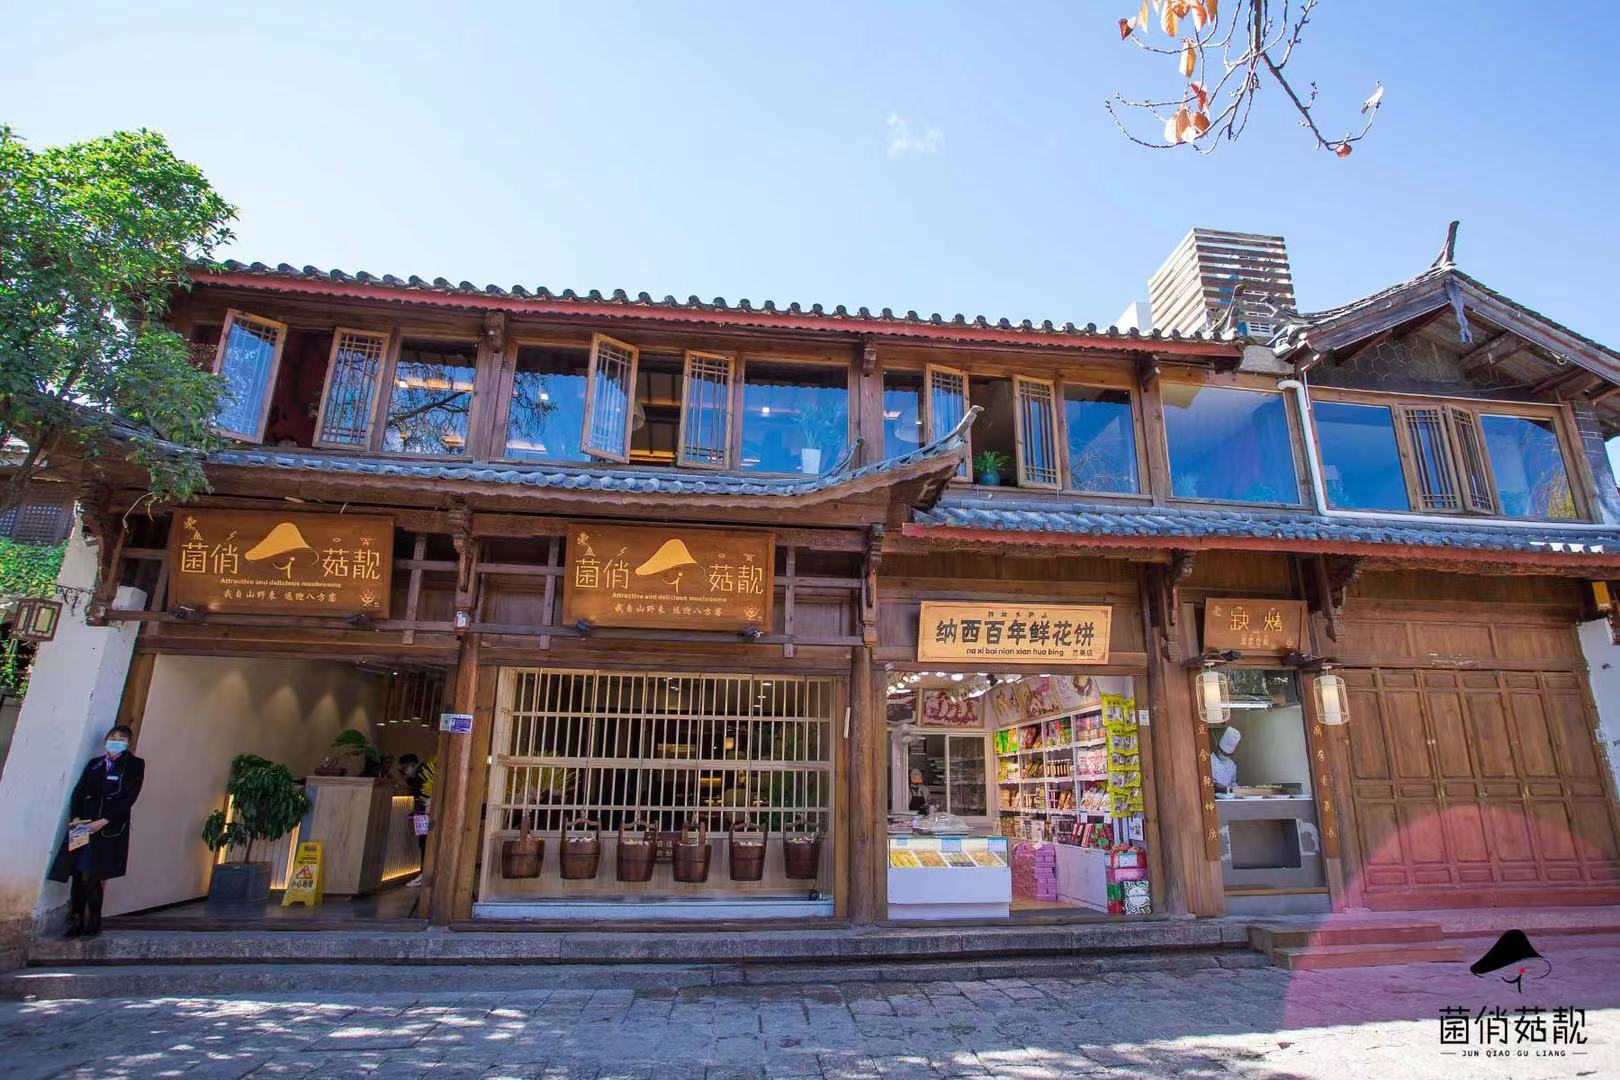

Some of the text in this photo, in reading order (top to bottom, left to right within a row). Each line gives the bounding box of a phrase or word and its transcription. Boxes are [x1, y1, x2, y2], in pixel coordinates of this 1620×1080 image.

[181, 542, 381, 580] 菌俏 菇靓
[220, 577, 254, 585] Attractive
[269, 579, 300, 587] delicious
[301, 581, 342, 589] mushrooms
[575, 558, 764, 594] 菌俏 菇靓
[611, 592, 644, 600] Attractive
[658, 594, 688, 602] delicious
[688, 595, 727, 603] mushrooms
[936, 618, 1095, 647] 纳西百年鲜花饼
[1048, 649, 1064, 657] bing
